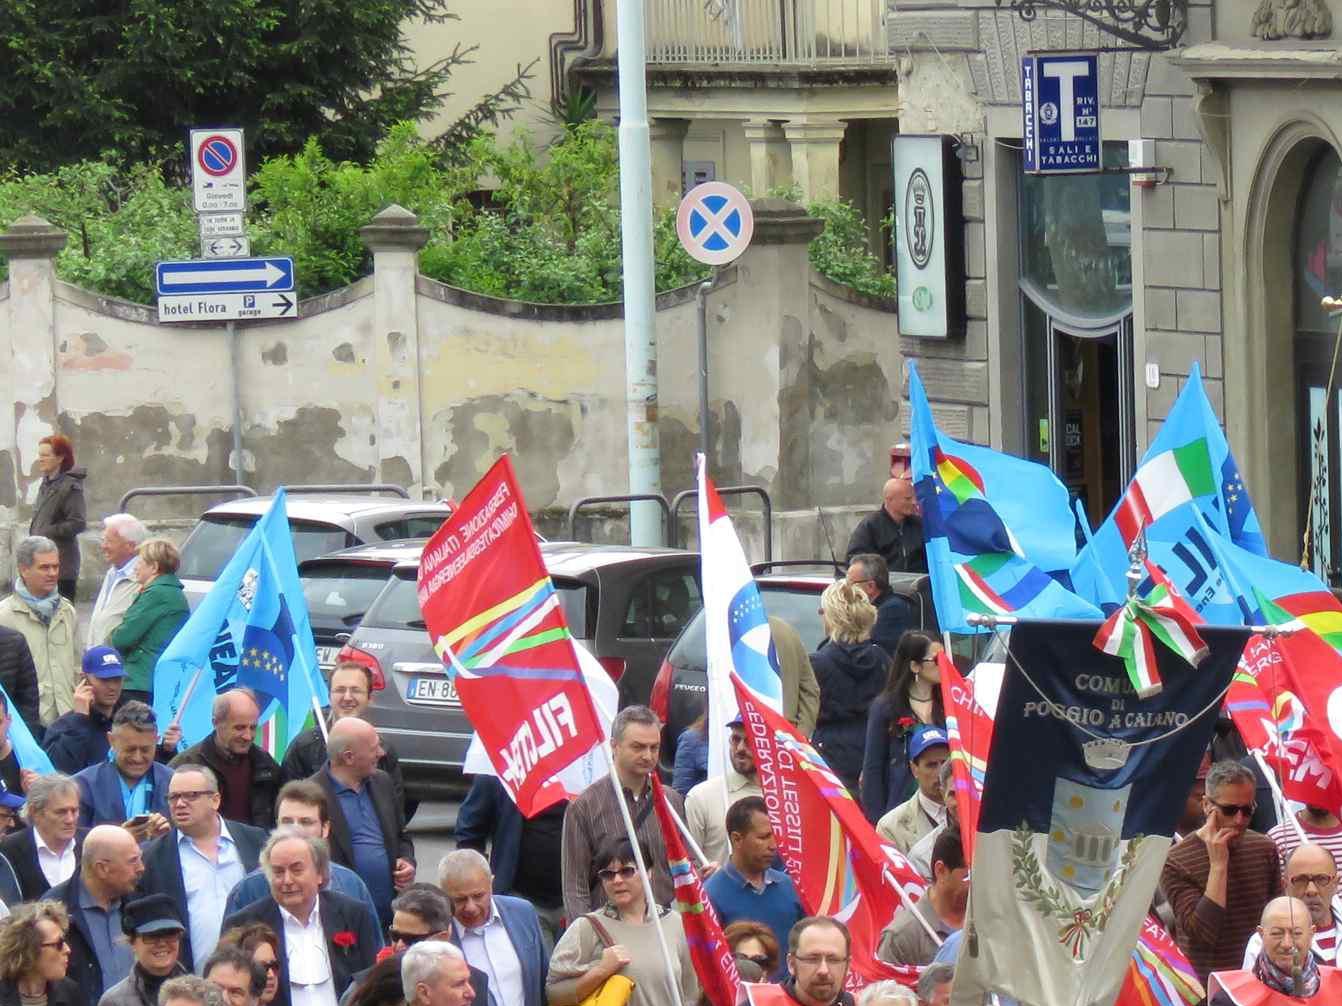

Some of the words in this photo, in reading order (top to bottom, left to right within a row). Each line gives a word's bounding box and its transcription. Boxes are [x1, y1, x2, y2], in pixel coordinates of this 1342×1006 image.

[1043, 61, 1090, 142] T
[1023, 65, 1034, 163] TABACCHI
[1049, 145, 1078, 155] SALI
[1084, 145, 1092, 154] E
[1041, 154, 1098, 165] TABACCHI
[163, 303, 194, 316] hotel
[198, 301, 227, 314] Flora
[418, 680, 436, 698] EN
[674, 683, 706, 693] PEUGEO
[1111, 698, 1125, 711] DI
[1023, 700, 1105, 726] POGGIO
[1108, 713, 1121, 729] A
